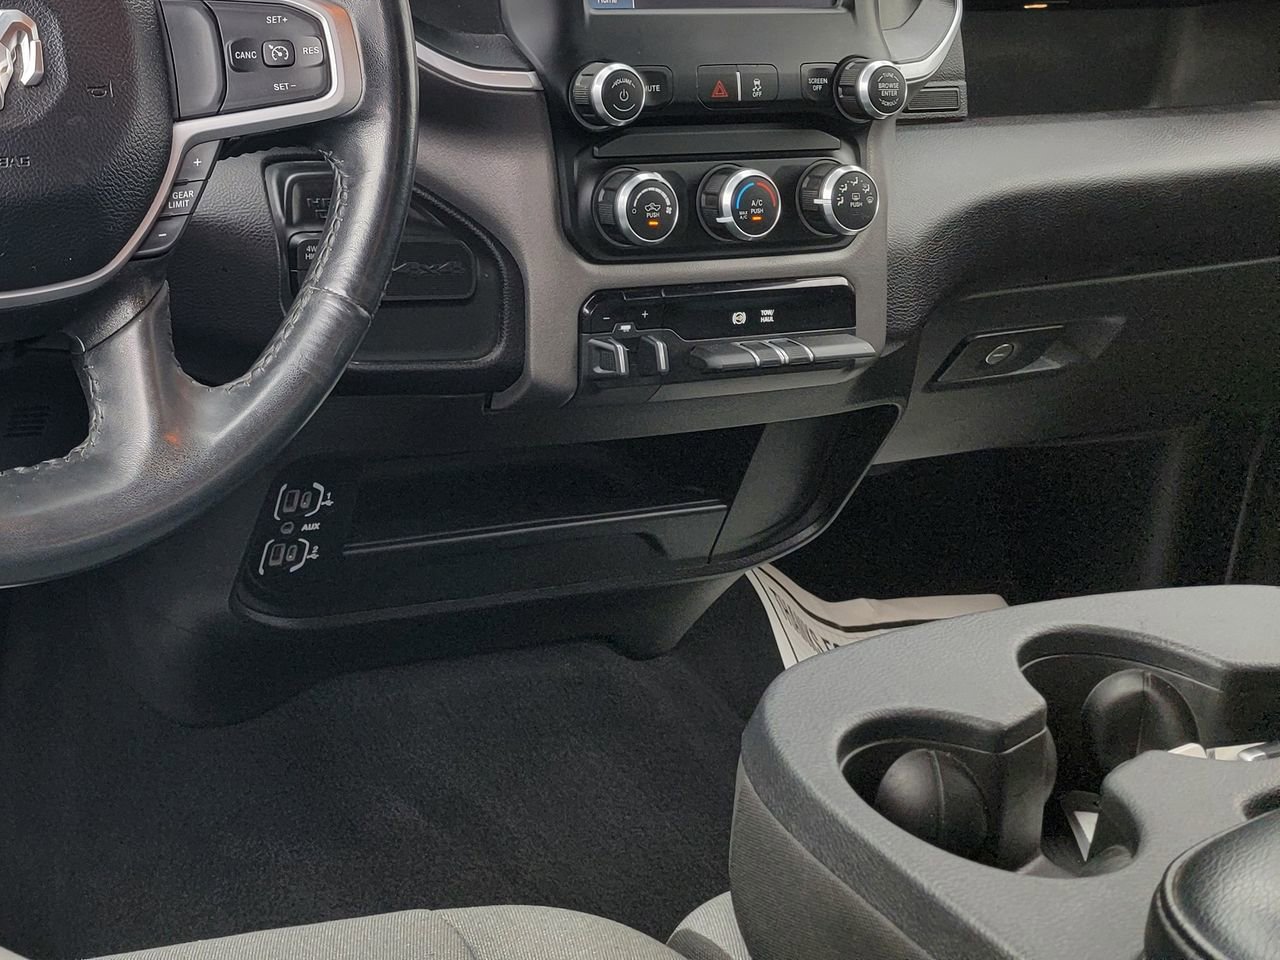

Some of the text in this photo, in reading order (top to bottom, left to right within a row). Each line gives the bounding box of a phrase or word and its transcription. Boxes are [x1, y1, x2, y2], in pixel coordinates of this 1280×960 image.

[234, 50, 257, 60] CANC
[302, 46, 320, 56] RES
[614, 78, 633, 86] VOLUME
[172, 190, 194, 200] GEAR
[168, 200, 190, 209] LIMIT
[326, 492, 332, 500] 1
[301, 523, 320, 532] AUX
